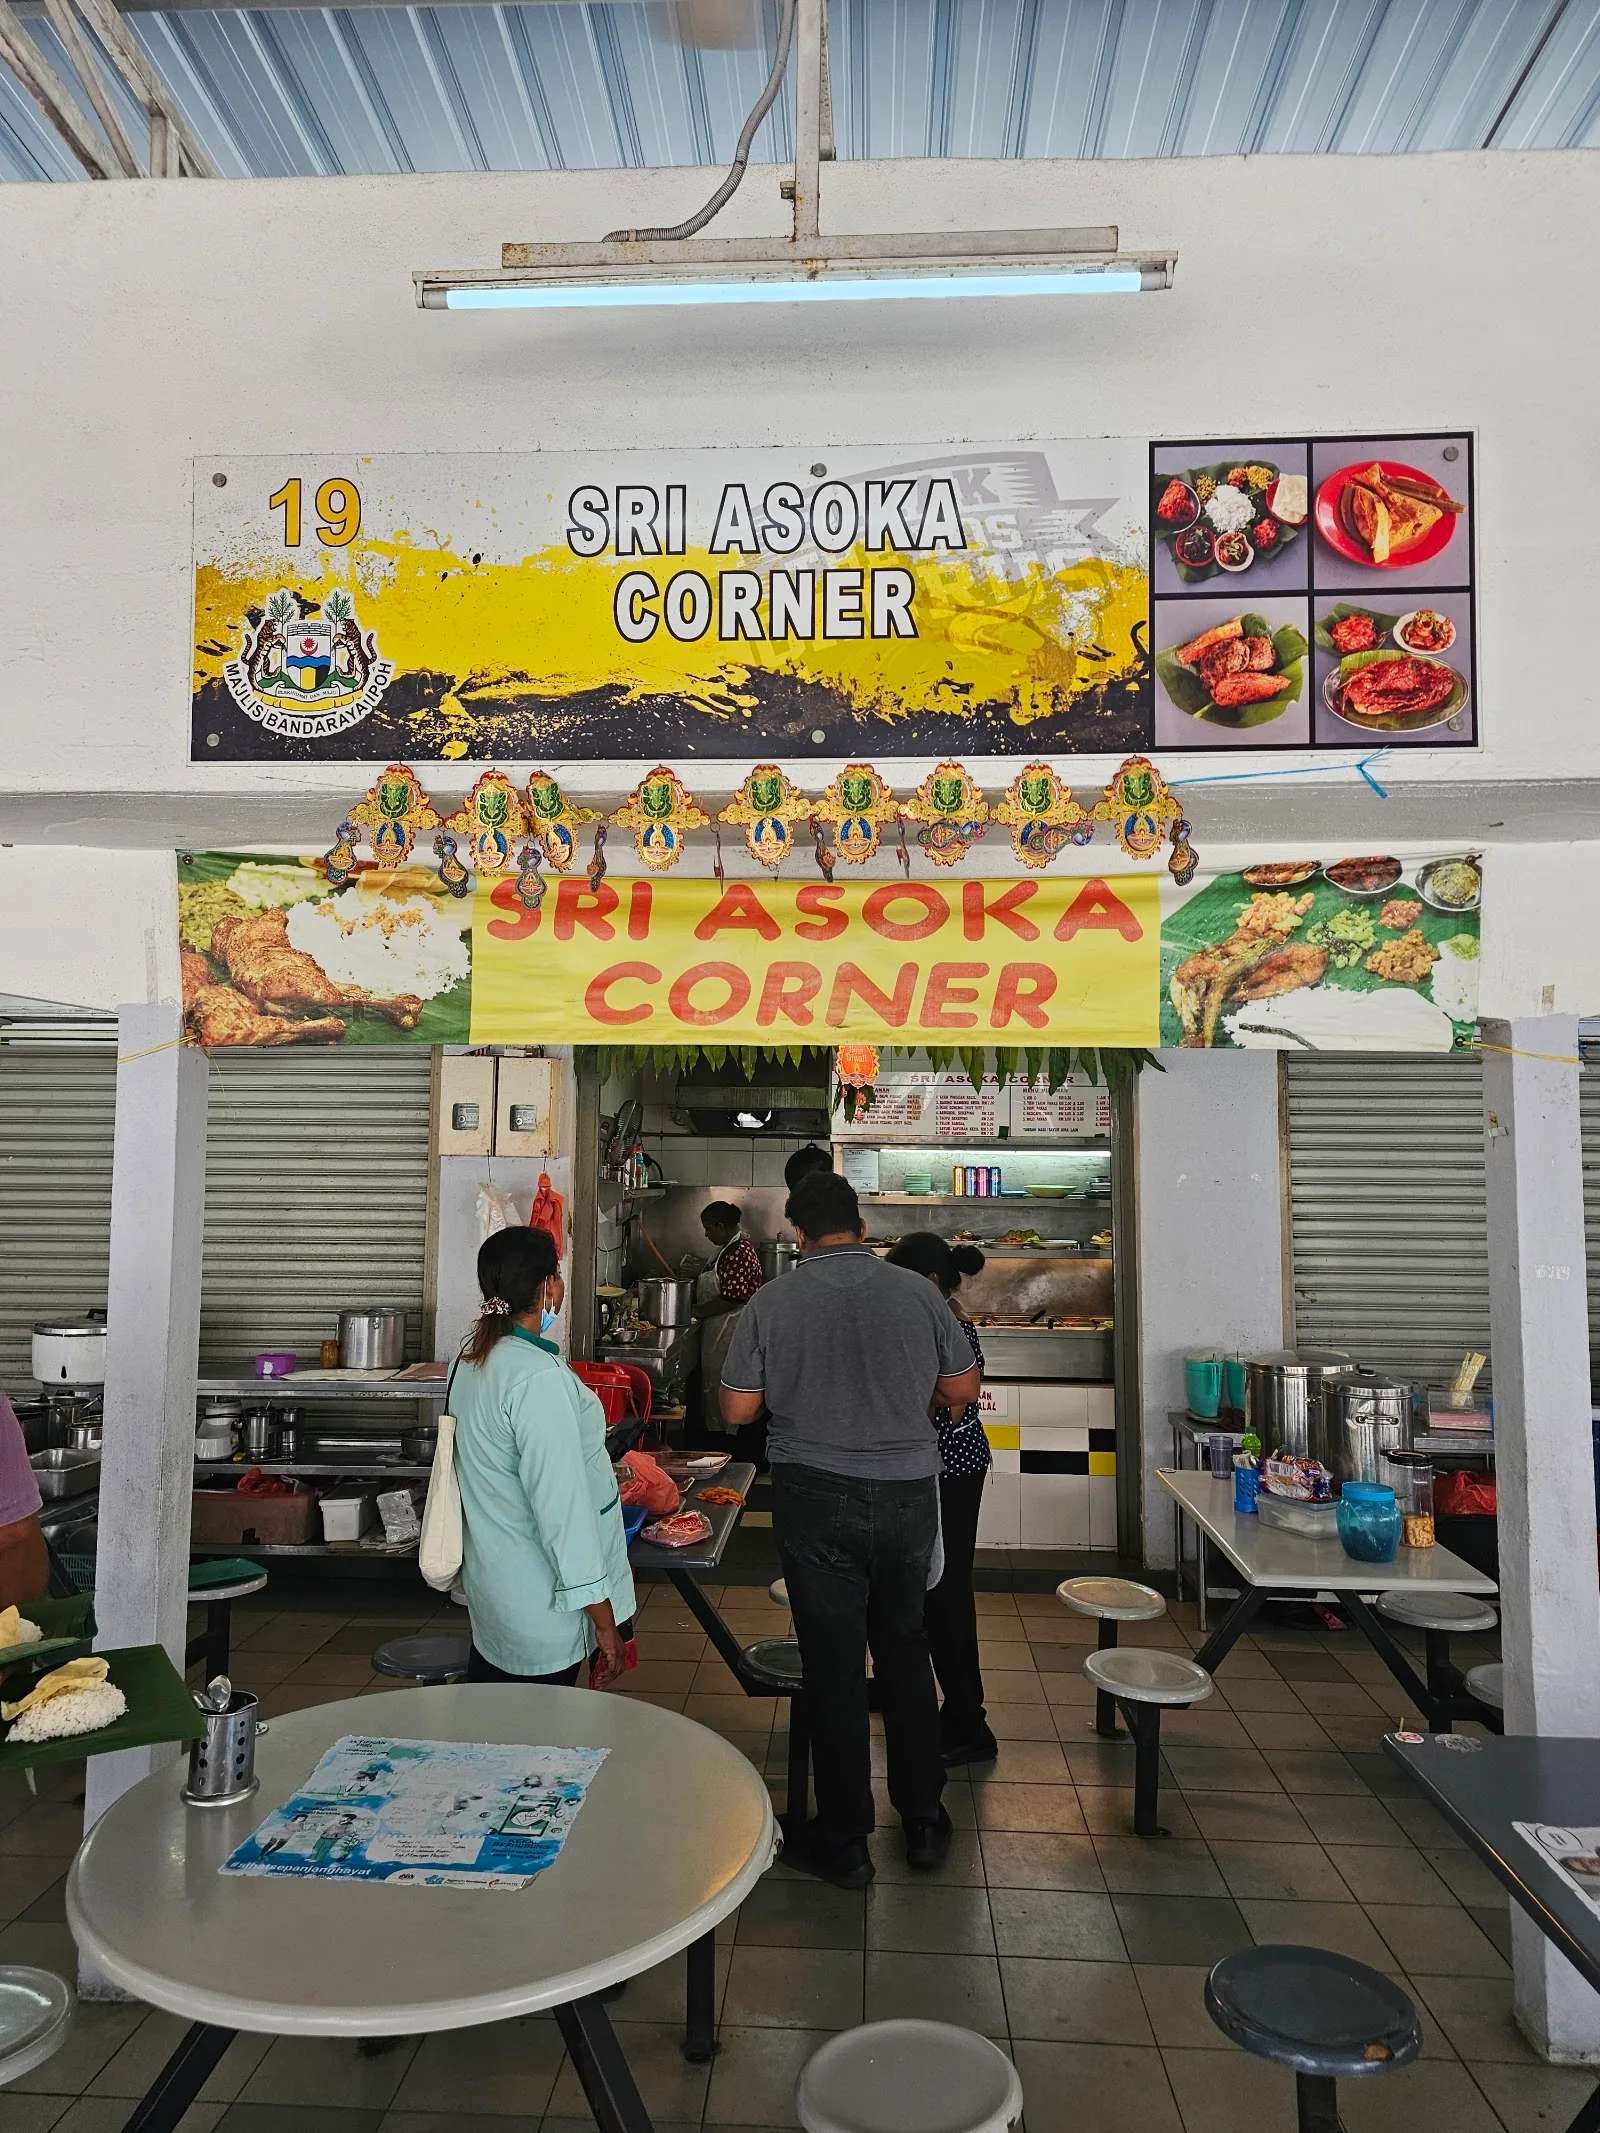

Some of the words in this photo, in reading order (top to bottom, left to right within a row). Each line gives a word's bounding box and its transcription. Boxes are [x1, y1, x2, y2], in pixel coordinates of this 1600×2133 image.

[269, 477, 362, 548] 19
[567, 483, 687, 558] SRI
[708, 478, 967, 556] ASOKA
[614, 568, 919, 643] CORNER
[226, 663, 264, 718] MAJLIS
[266, 701, 368, 735] BANDARAYA
[369, 662, 392, 704] IPOH
[487, 878, 651, 941] SRI
[693, 879, 1143, 942] ASOKA
[584, 961, 1058, 1029] CORNER
[910, 1075, 936, 1083] SRI
